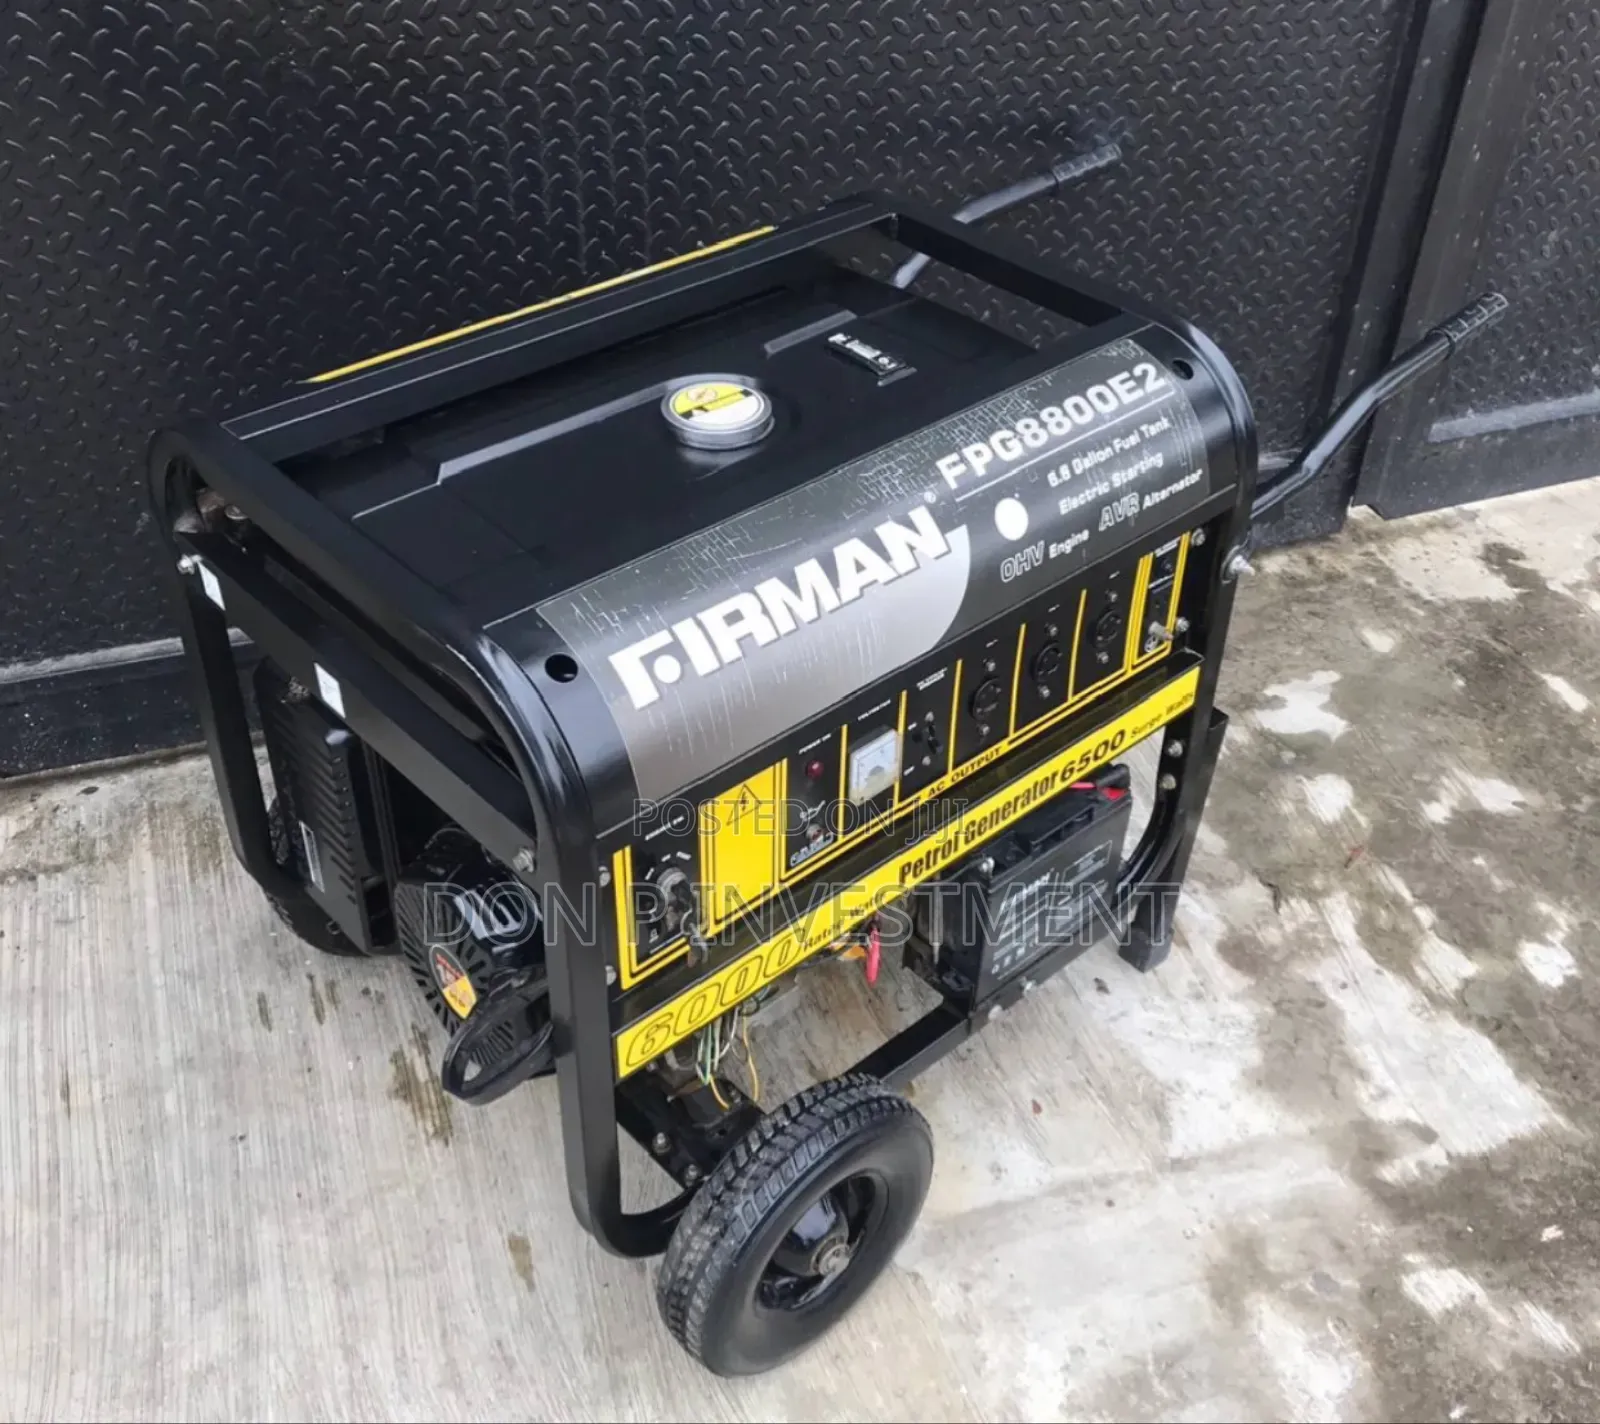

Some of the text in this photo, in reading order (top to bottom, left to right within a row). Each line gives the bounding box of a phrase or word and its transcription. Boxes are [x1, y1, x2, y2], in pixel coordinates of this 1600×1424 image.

[936, 363, 1165, 490] FPG8800E2
[1058, 451, 1164, 516] Electric Starting
[1114, 433, 1141, 452] Fuel
[1140, 416, 1171, 438] Tank
[1000, 468, 1203, 583] OHV Engine AVR Alternator
[607, 504, 953, 711] FIRMAN
[928, 746, 1003, 797] AC OUTPUT
[625, 927, 806, 1068] 6000
[898, 825, 960, 884] Petrol
[963, 767, 1063, 846] Generator
[1059, 728, 1126, 783] 6500
